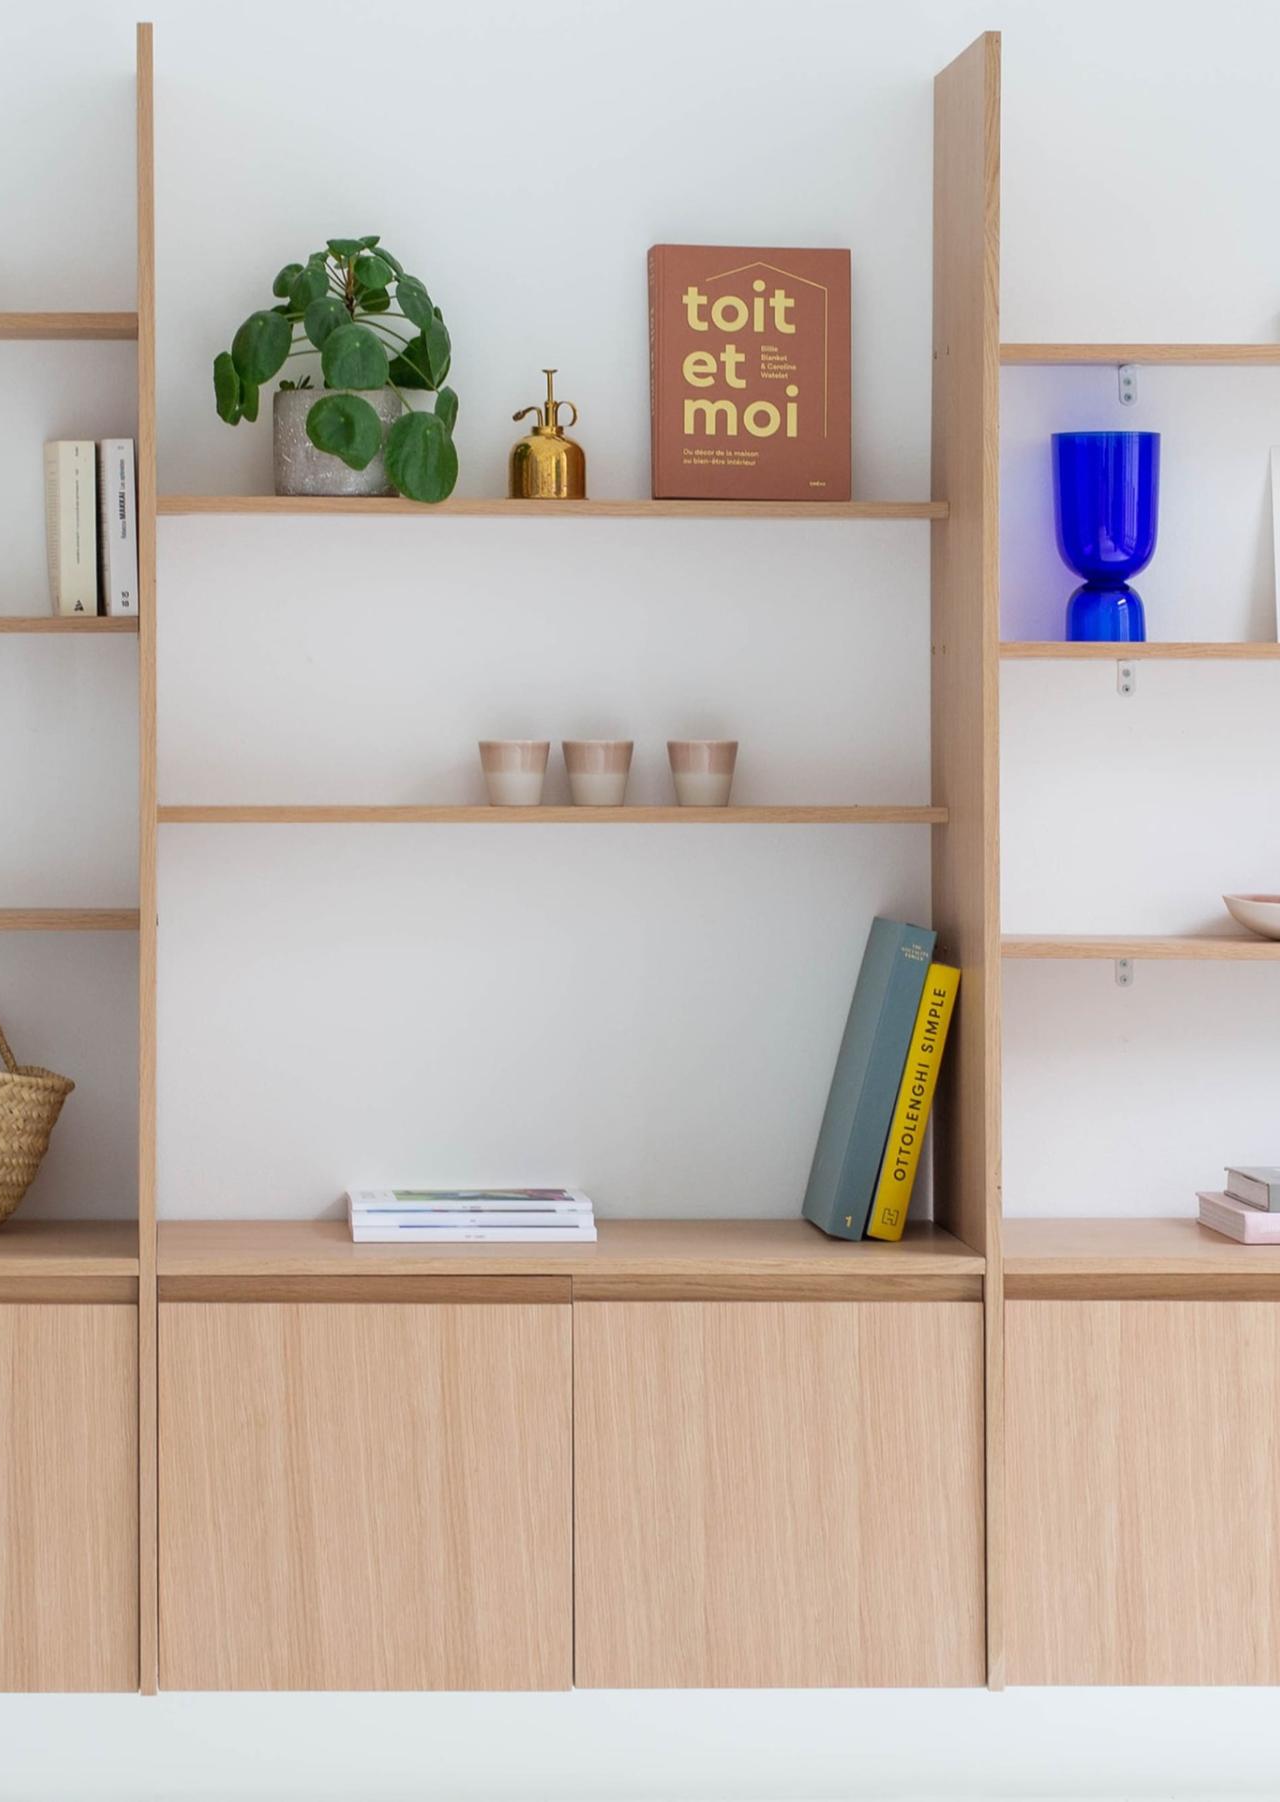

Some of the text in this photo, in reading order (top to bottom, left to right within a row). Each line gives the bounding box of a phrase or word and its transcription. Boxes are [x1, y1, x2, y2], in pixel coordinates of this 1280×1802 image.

[682, 279, 796, 335] toit
[682, 344, 747, 389] et
[683, 384, 800, 438] moi
[715, 448, 725, 457] de
[733, 449, 760, 459] maison
[893, 987, 947, 1182] OTTOLENGHI SIMPLE
